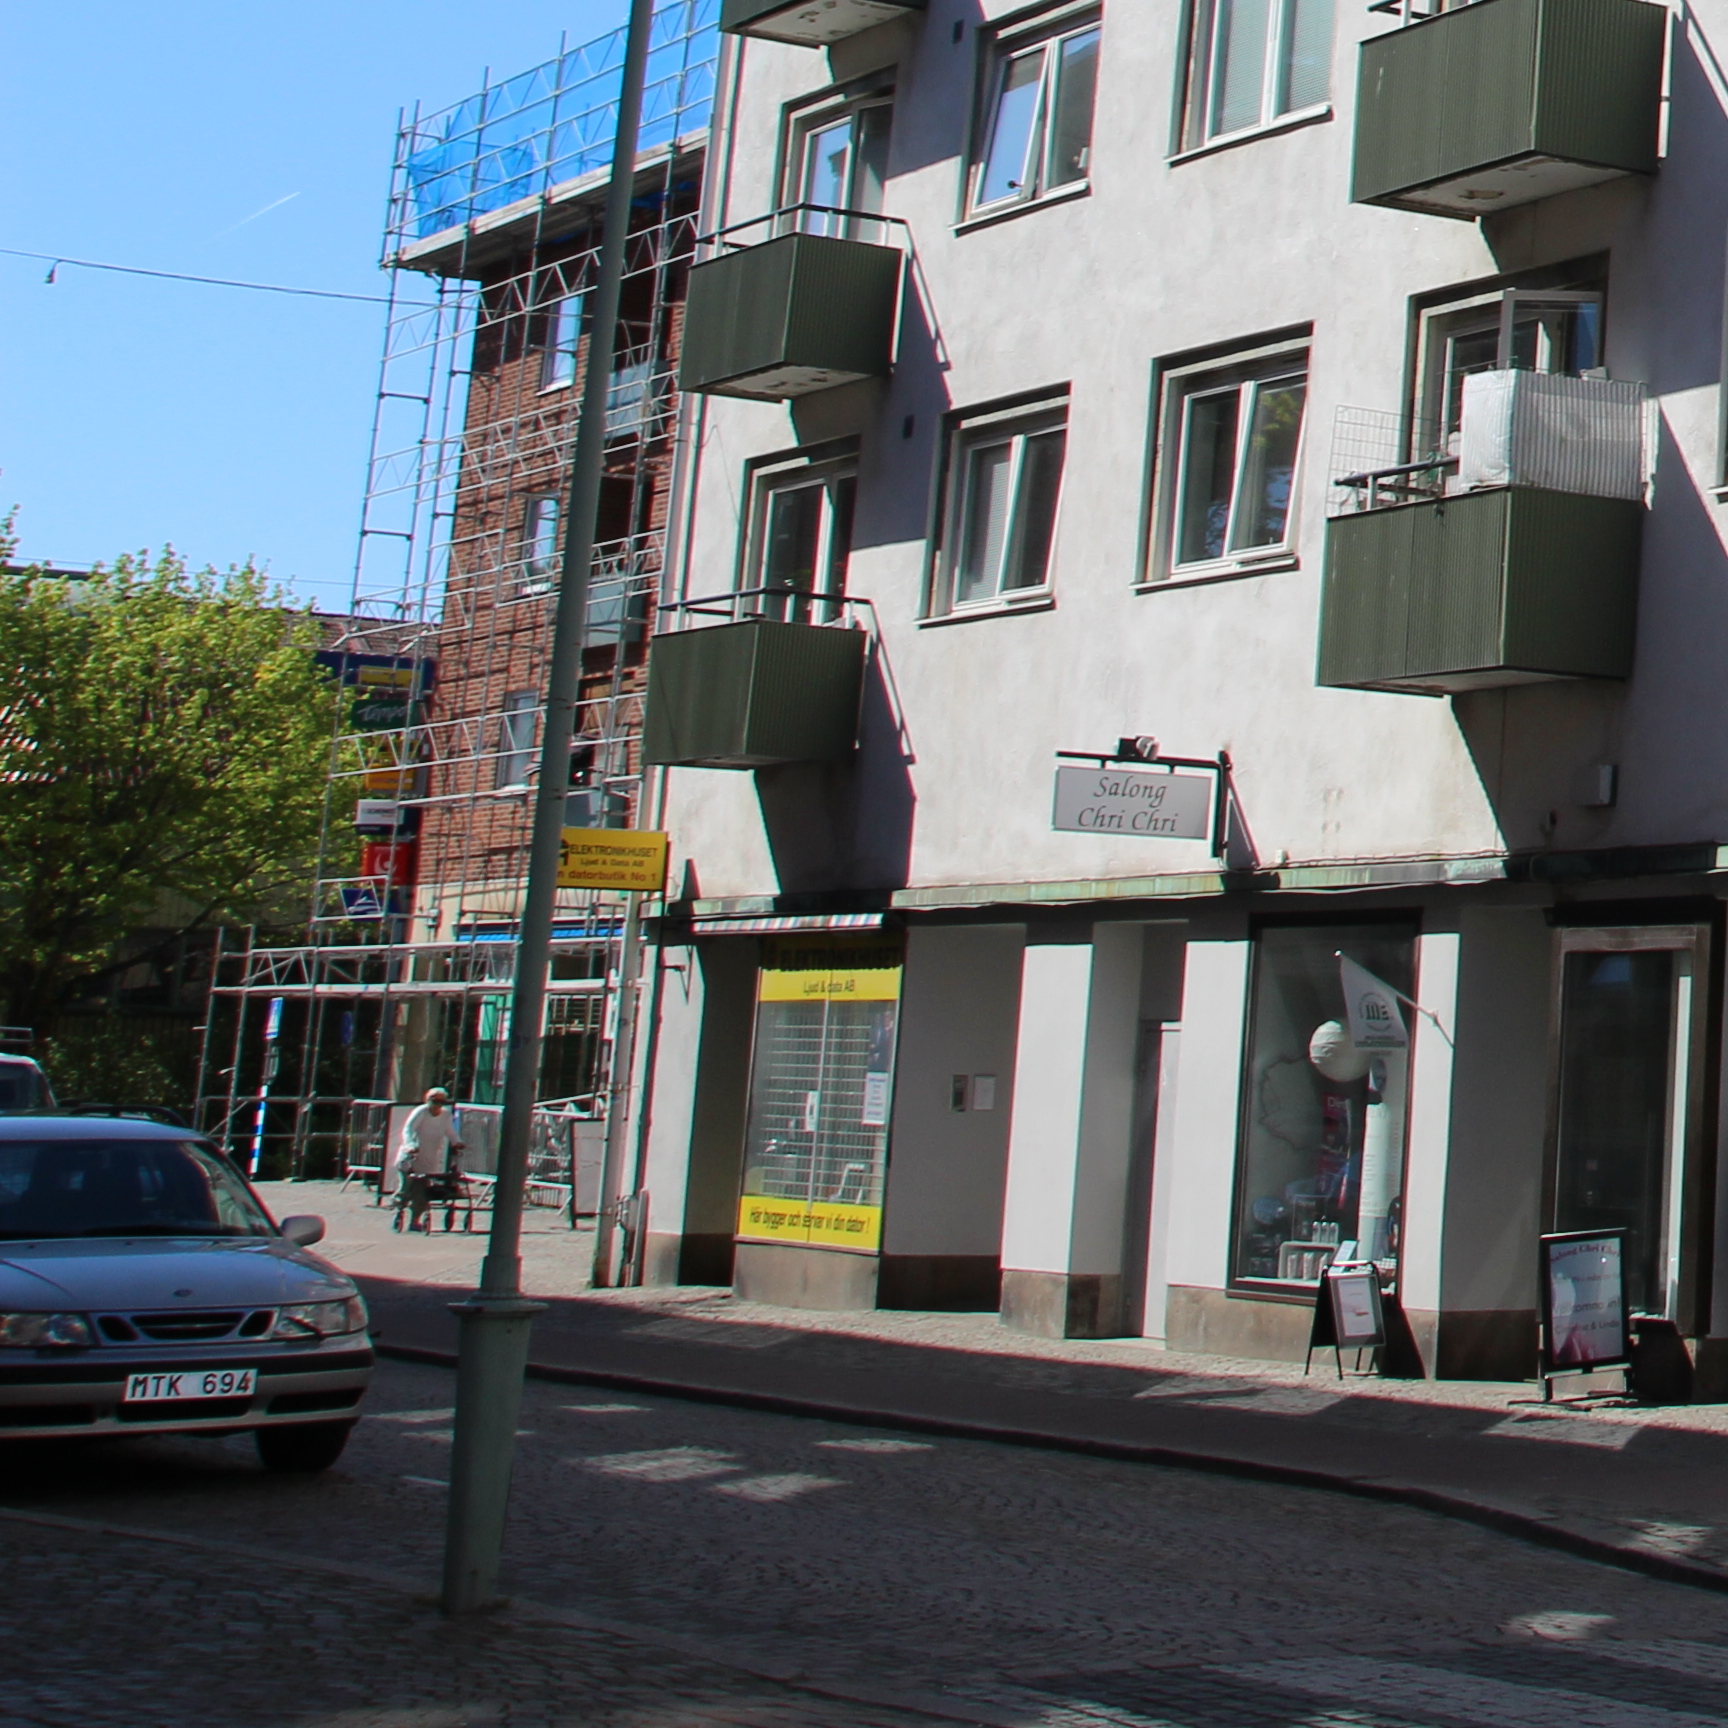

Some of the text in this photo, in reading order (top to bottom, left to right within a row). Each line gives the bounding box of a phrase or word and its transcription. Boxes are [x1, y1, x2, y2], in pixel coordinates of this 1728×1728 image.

[1094, 775, 1168, 808] Salong
[1078, 805, 1179, 832] Chri Chri
[569, 844, 658, 858] ELEKTRONIKHUSET
[568, 870, 626, 881] datorbutik
[131, 1370, 253, 1398] MTK 694
